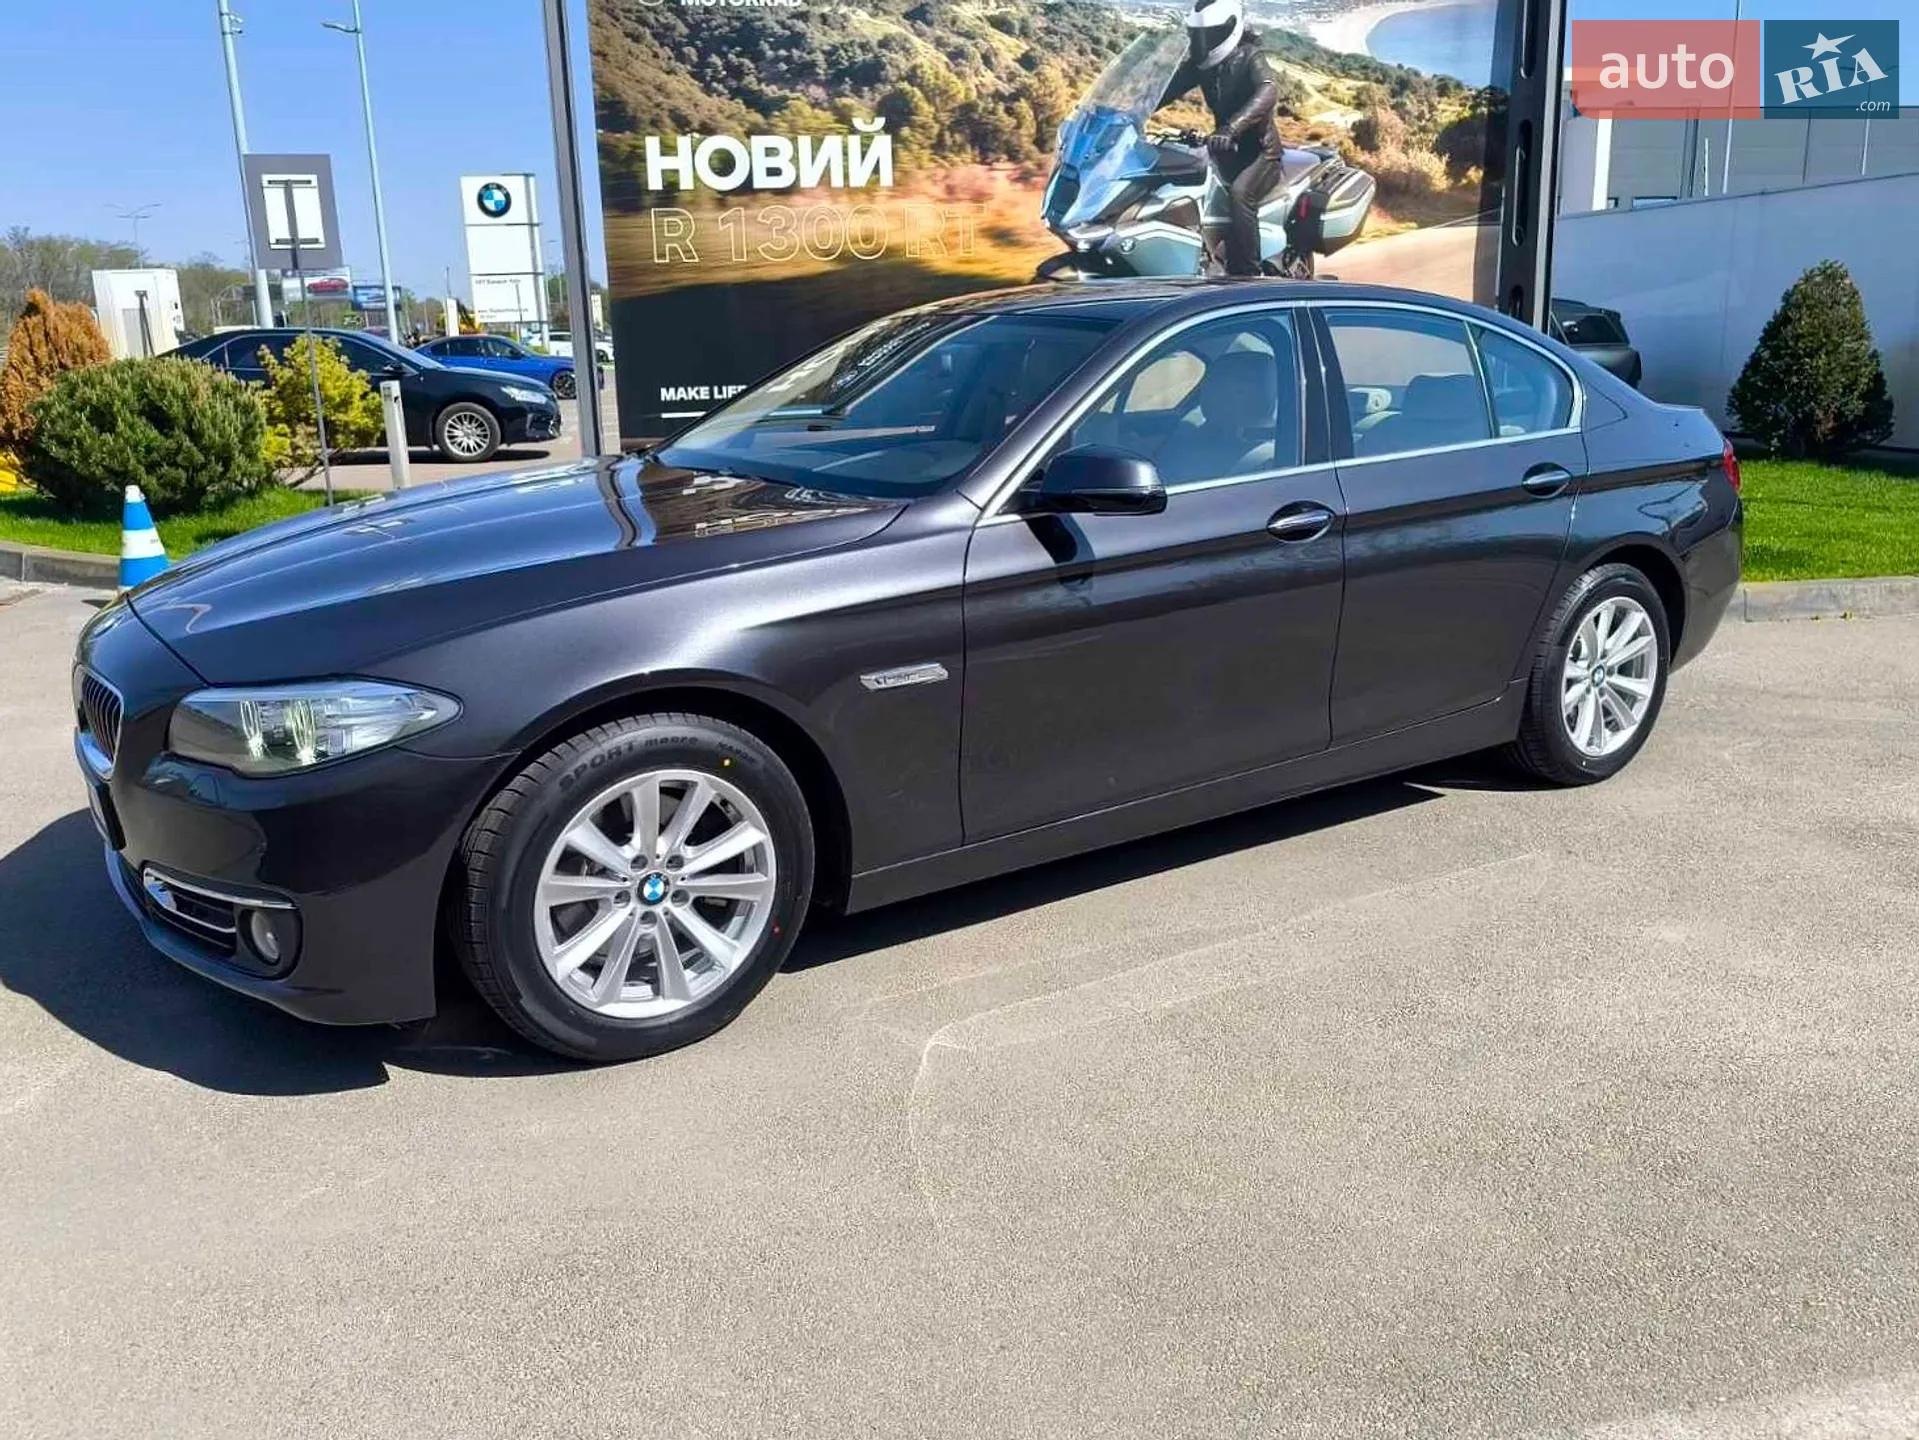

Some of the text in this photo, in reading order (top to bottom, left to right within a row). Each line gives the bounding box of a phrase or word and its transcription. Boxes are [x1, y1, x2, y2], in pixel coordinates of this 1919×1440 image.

[644, 116, 894, 191] НОВИЙ
[650, 203, 988, 264] R 1300 RT
[660, 386, 711, 401] MAKE
[558, 739, 635, 792] SPORT
